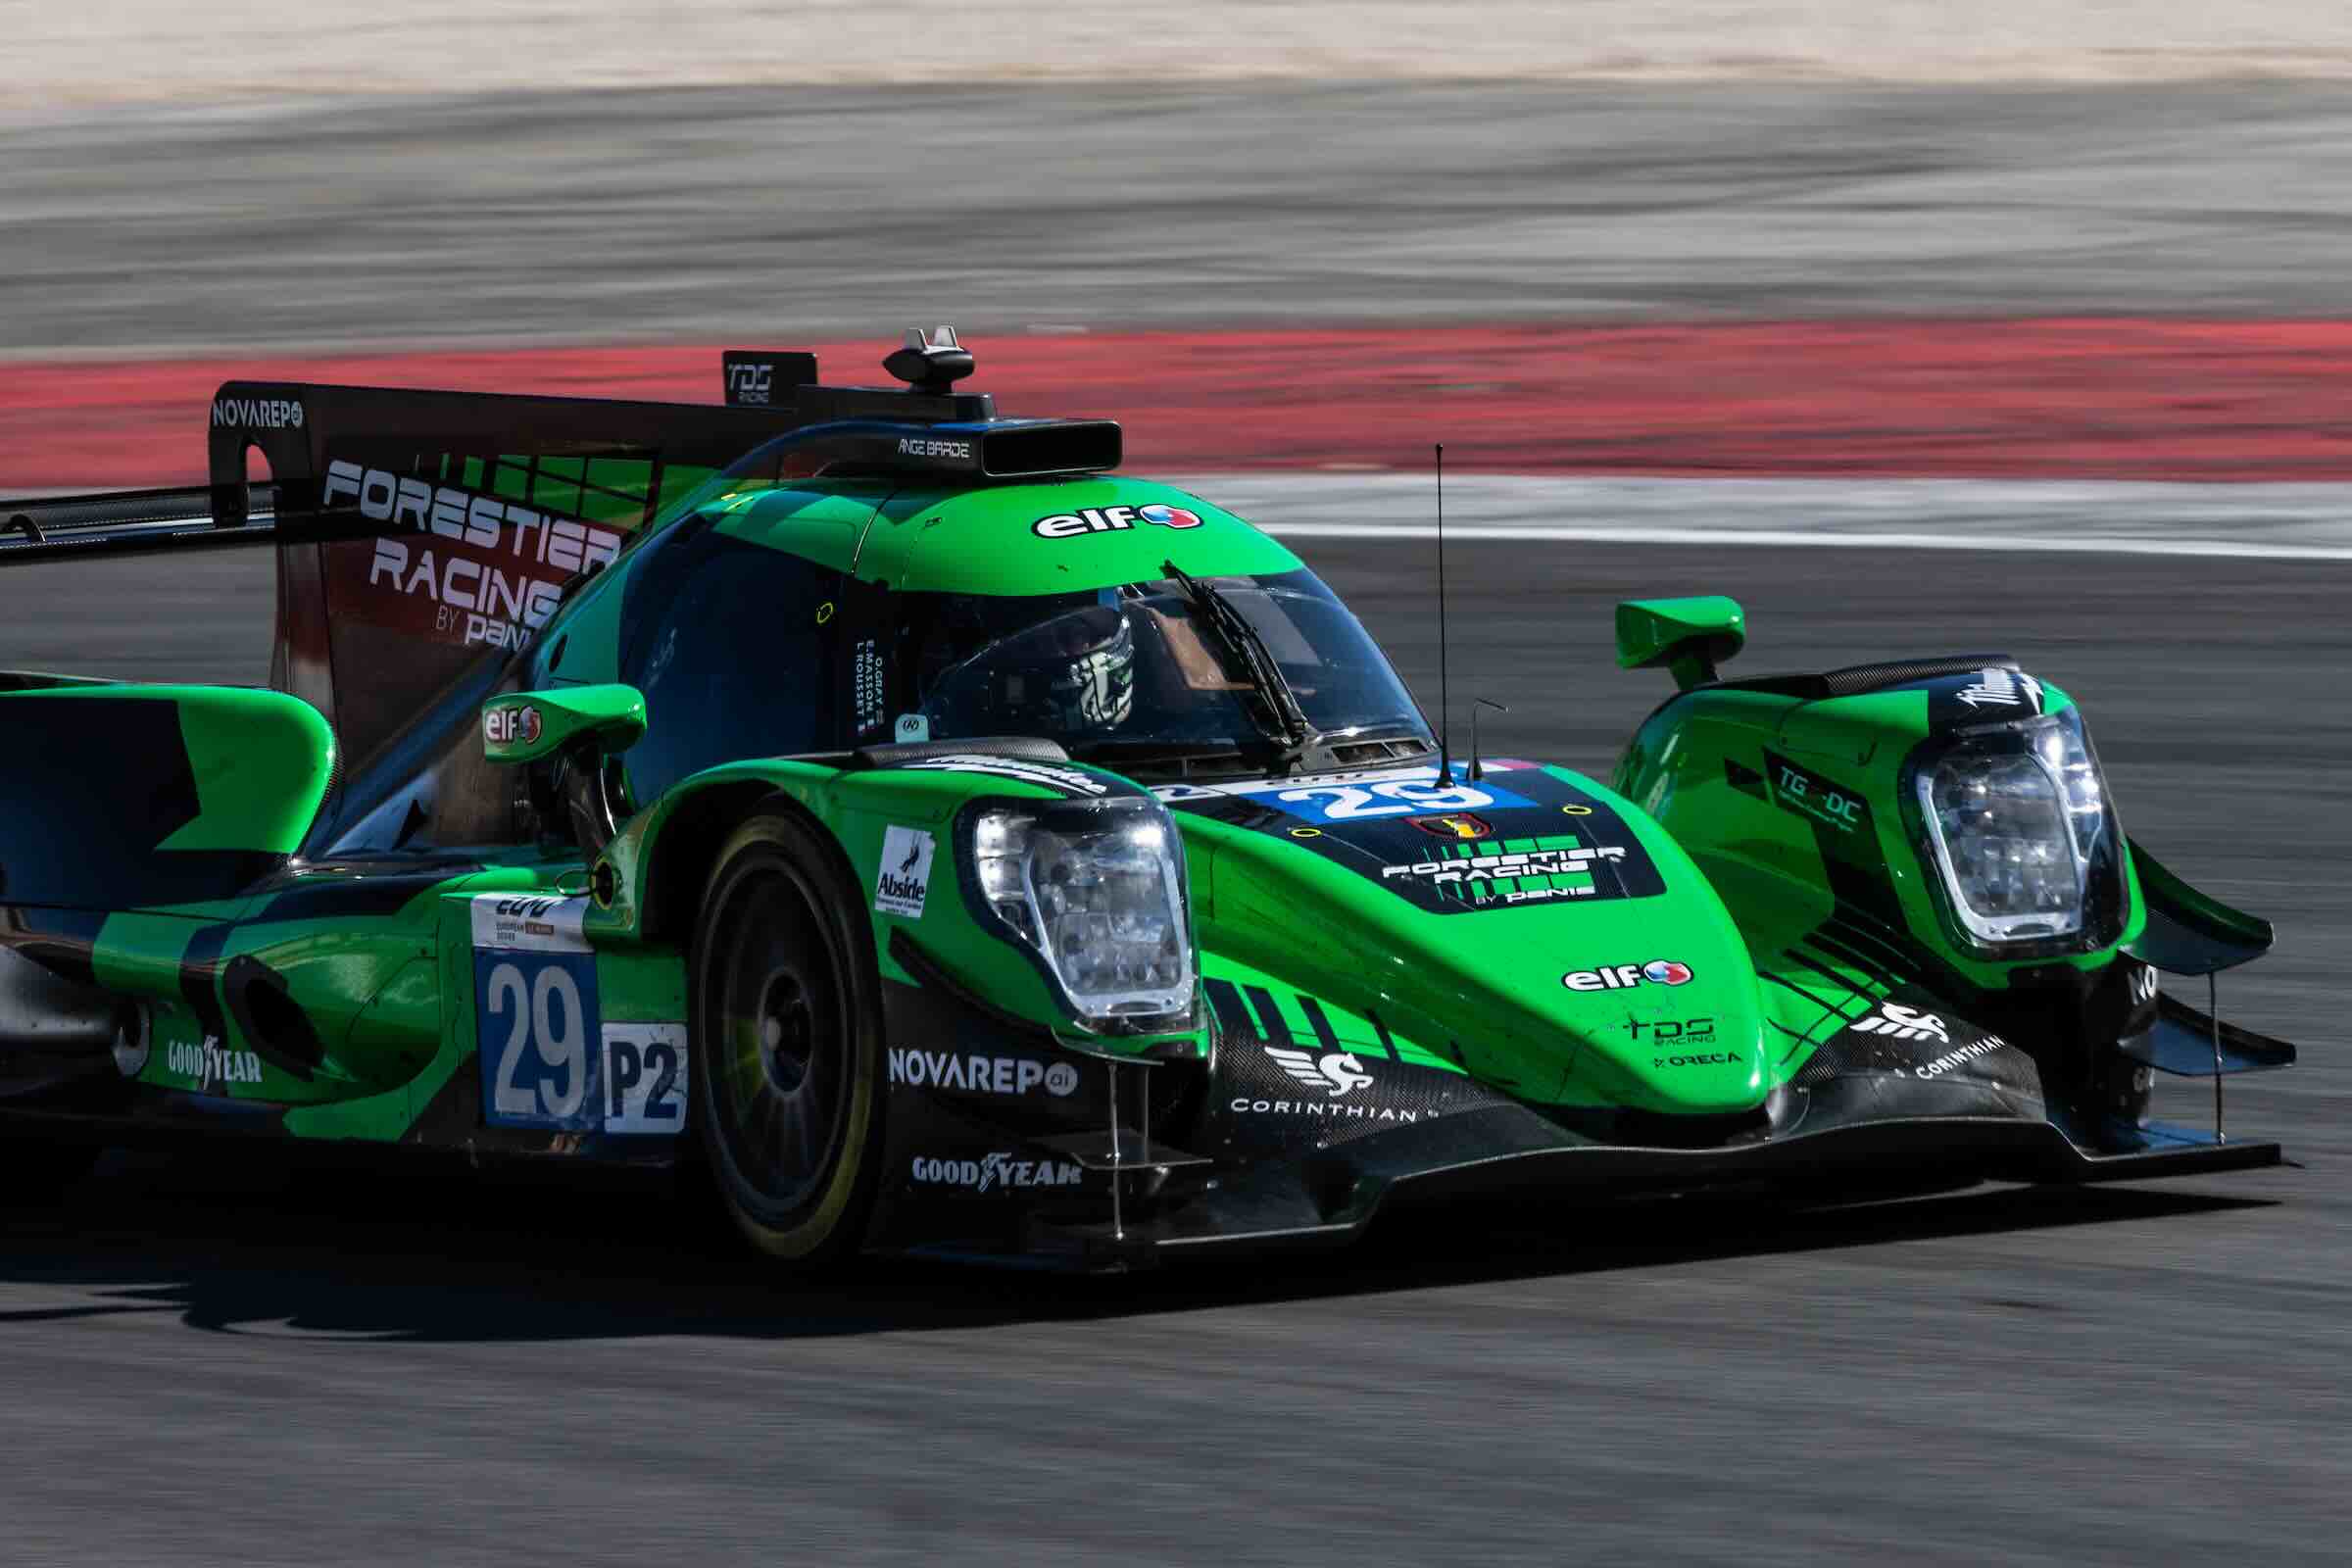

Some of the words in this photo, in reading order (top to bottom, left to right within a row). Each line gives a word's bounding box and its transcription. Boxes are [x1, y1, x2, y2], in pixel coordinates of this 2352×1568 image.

[898, 438, 926, 455] ANGE
[926, 441, 970, 459] BARDE
[323, 460, 622, 573] FORESTIER
[369, 538, 564, 628] RACING
[435, 604, 461, 635] BY
[1278, 780, 1494, 819] 29
[1382, 847, 1628, 878] FORESTIER
[1434, 859, 1590, 884] RACING
[878, 872, 926, 902] Abside
[488, 962, 587, 1118] 29
[1915, 1034, 2007, 1079] CORINTHIAN
[168, 1036, 263, 1087] GOODYEAR
[608, 1041, 679, 1120] P2
[1231, 1099, 1417, 1122] CORINTHIAN
[911, 1153, 1083, 1190] GOODYEAR
